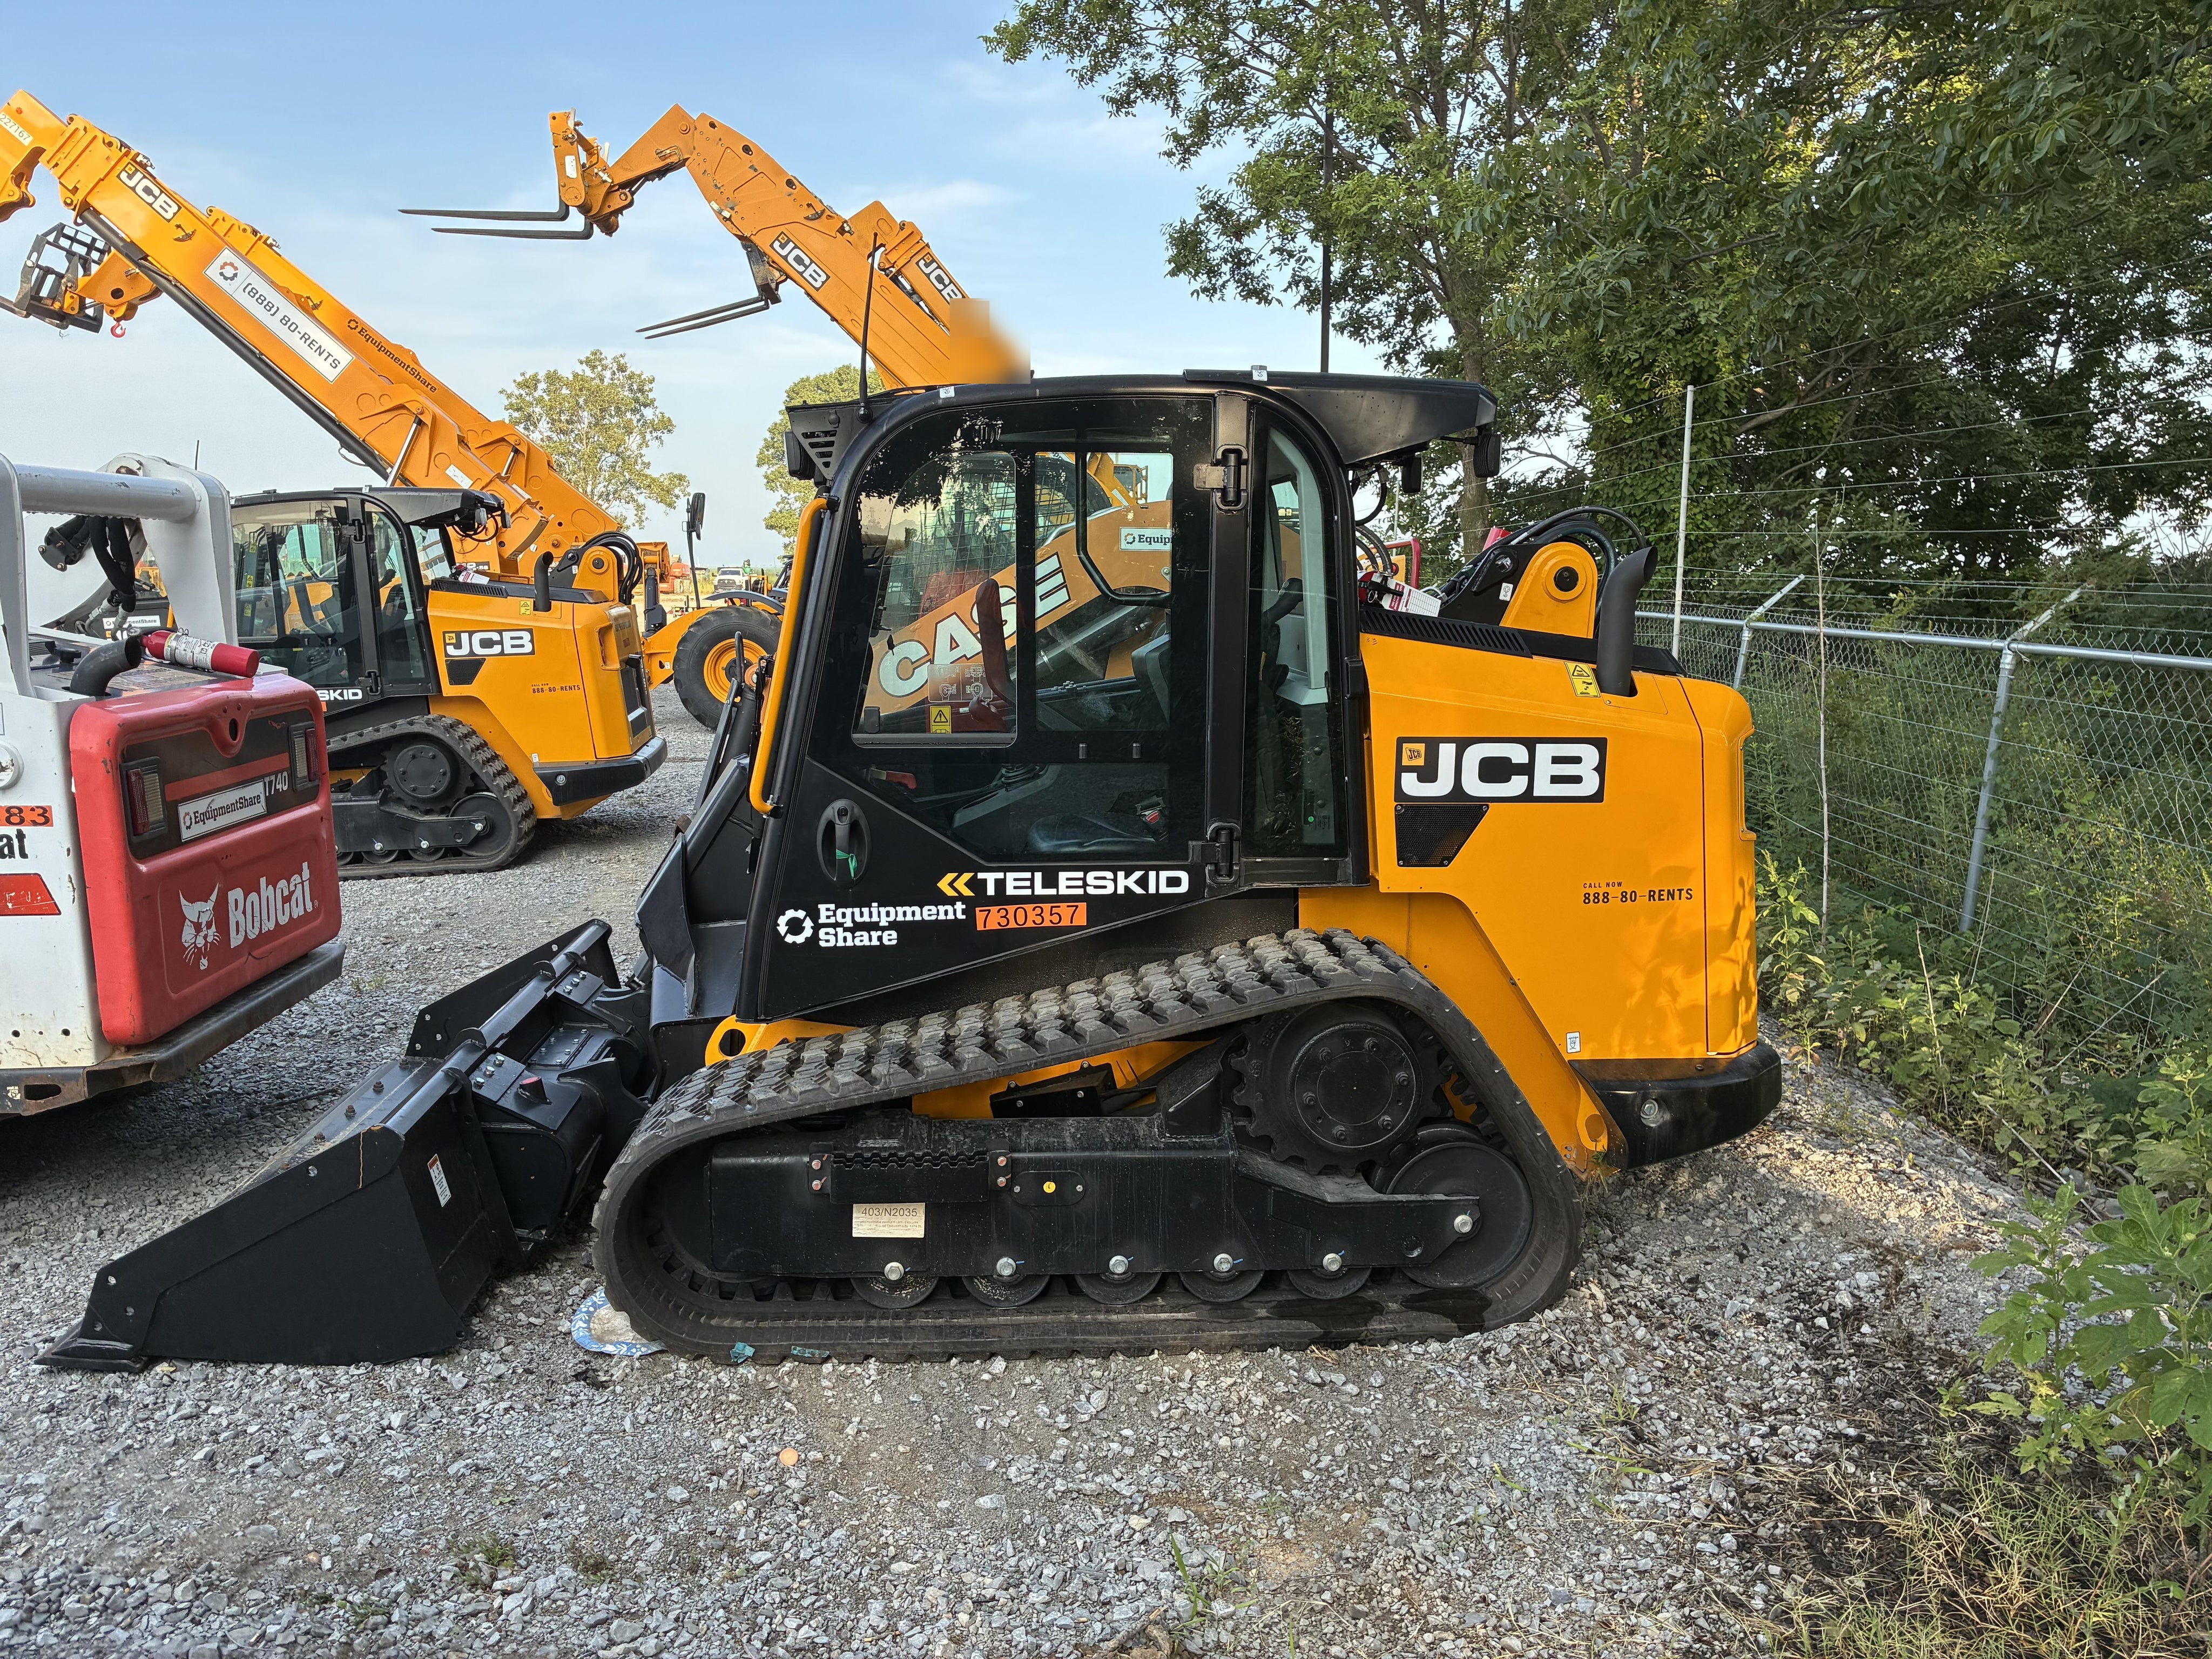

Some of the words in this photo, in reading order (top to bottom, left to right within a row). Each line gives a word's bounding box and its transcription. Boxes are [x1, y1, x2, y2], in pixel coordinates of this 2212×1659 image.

[0, 114, 30, 140] 227167
[119, 167, 179, 219] JCB
[773, 240, 827, 288] JCB
[242, 282, 280, 317] (888)
[279, 314, 341, 369] 80-RENTS
[357, 327, 437, 393] EquipmentShare
[1137, 534, 1172, 545] Equip
[446, 631, 533, 656] JCB
[532, 684, 581, 694] 888-80-RENTS
[1407, 747, 1422, 761] JCB
[1401, 743, 1600, 797] JCB
[264, 771, 289, 797] T740
[0, 805, 50, 826] 83
[193, 793, 261, 825] EquipmentShare
[977, 870, 1189, 896] TELESKID
[228, 861, 313, 949] Bobcat
[1583, 888, 1694, 905] 888-80-RENTS
[818, 901, 966, 927] Equipment
[979, 904, 1080, 929] 730357
[818, 927, 898, 947] Share
[861, 1207, 918, 1217] 403/N2035
